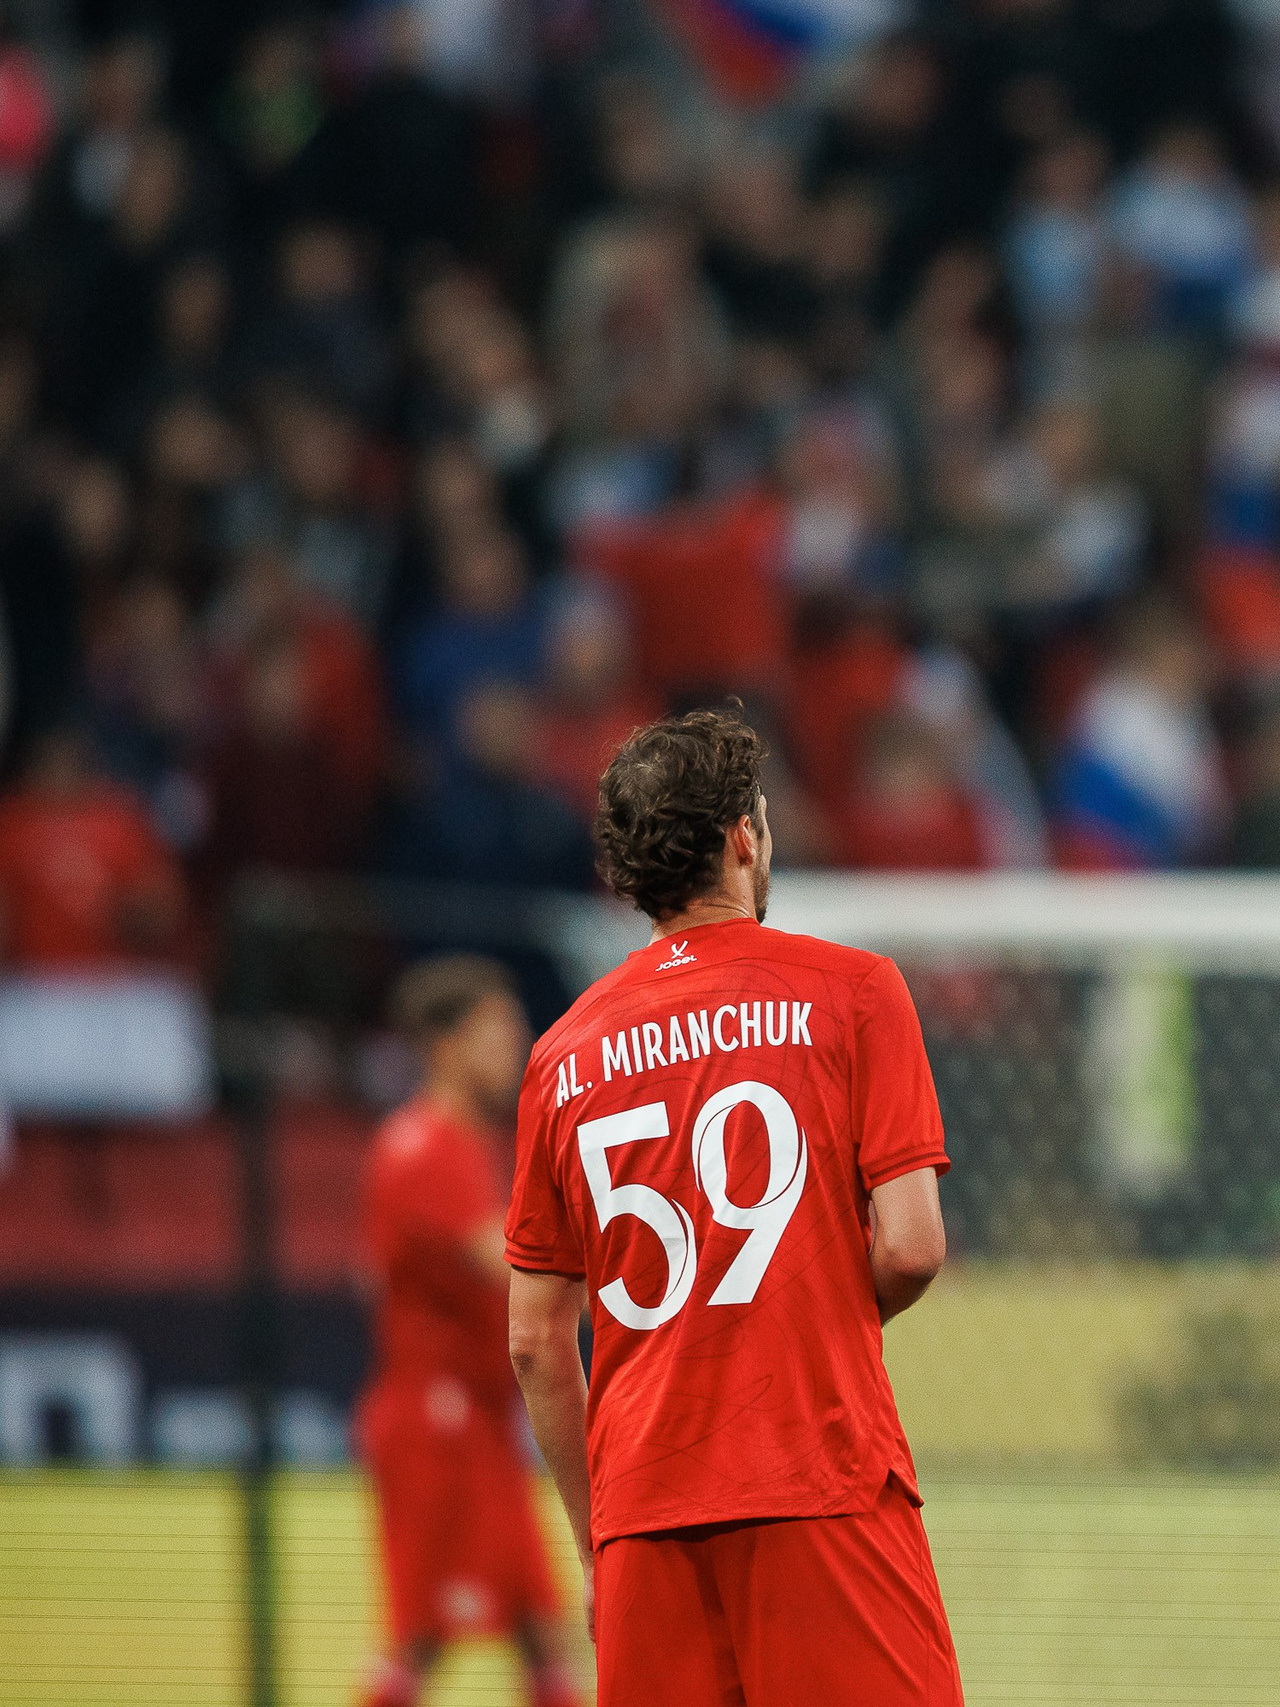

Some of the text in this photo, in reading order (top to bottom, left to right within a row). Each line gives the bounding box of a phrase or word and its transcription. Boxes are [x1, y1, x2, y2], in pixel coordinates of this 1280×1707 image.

[655, 954, 698, 972] JOGEL
[556, 1001, 813, 1108] AL. MIRANCHUK
[576, 1080, 808, 1331] 59
